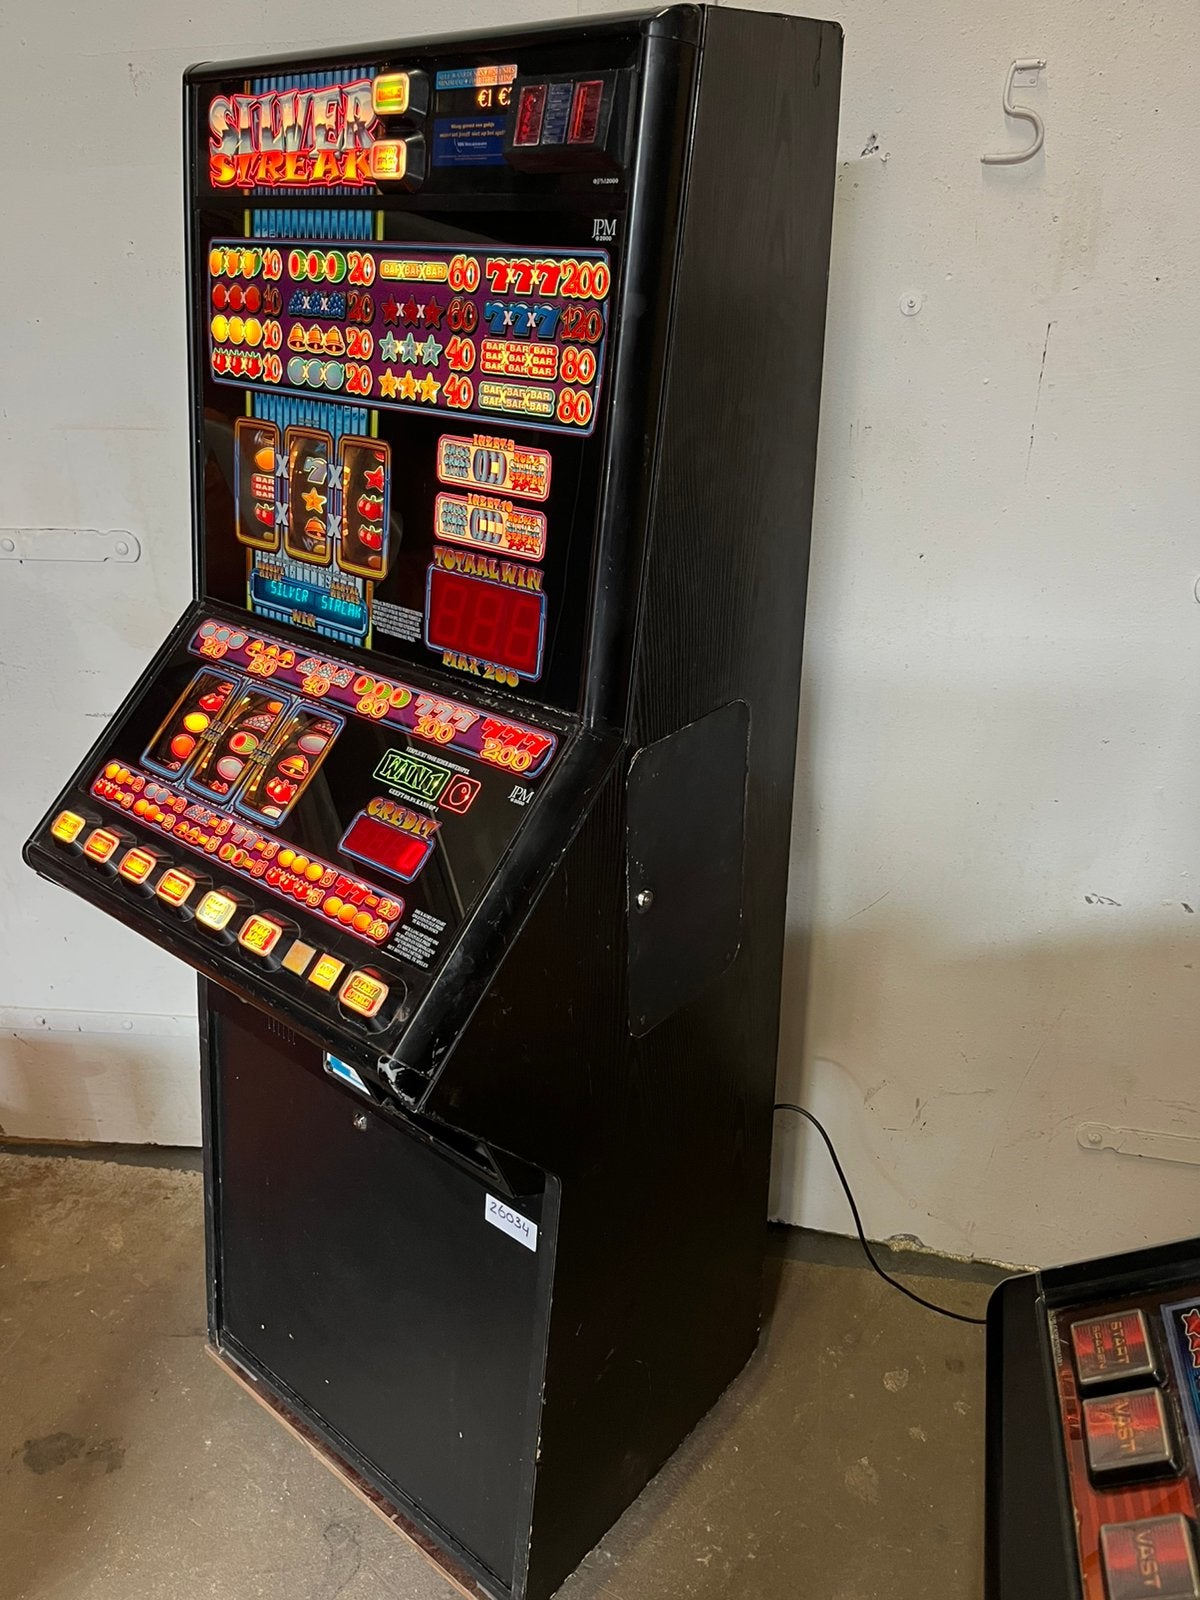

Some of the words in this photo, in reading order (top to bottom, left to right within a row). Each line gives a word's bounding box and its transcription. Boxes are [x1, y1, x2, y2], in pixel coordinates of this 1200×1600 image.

[209, 79, 377, 159] SILVER
[209, 149, 376, 187] STREAK
[592, 219, 617, 238] JPM
[263, 248, 282, 280] 10
[348, 251, 375, 286] 20
[448, 254, 480, 292] 60
[562, 258, 611, 299] 200
[561, 304, 603, 343] 120
[263, 319, 282, 350] 10
[346, 327, 373, 360] 20
[445, 335, 476, 372] 40
[263, 352, 282, 383] 10
[346, 362, 373, 395] 20
[444, 373, 474, 410] 40
[560, 346, 596, 385] 80
[557, 387, 593, 426] 80
[434, 546, 499, 581] TOTAAL
[501, 562, 544, 591] WIN
[271, 581, 309, 602] SILVER
[321, 595, 361, 618] STREAK
[291, 609, 317, 628] WIN
[442, 651, 481, 676] MAX
[483, 663, 519, 688] 200
[413, 715, 455, 744] 100
[480, 738, 533, 772] 200
[508, 785, 535, 804] JPM
[367, 798, 441, 839] CREDIT
[490, 1201, 530, 1238] 26034
[1111, 1321, 1130, 1364] START
[1114, 1400, 1136, 1453] VAST
[1136, 1529, 1162, 1589] VAST
